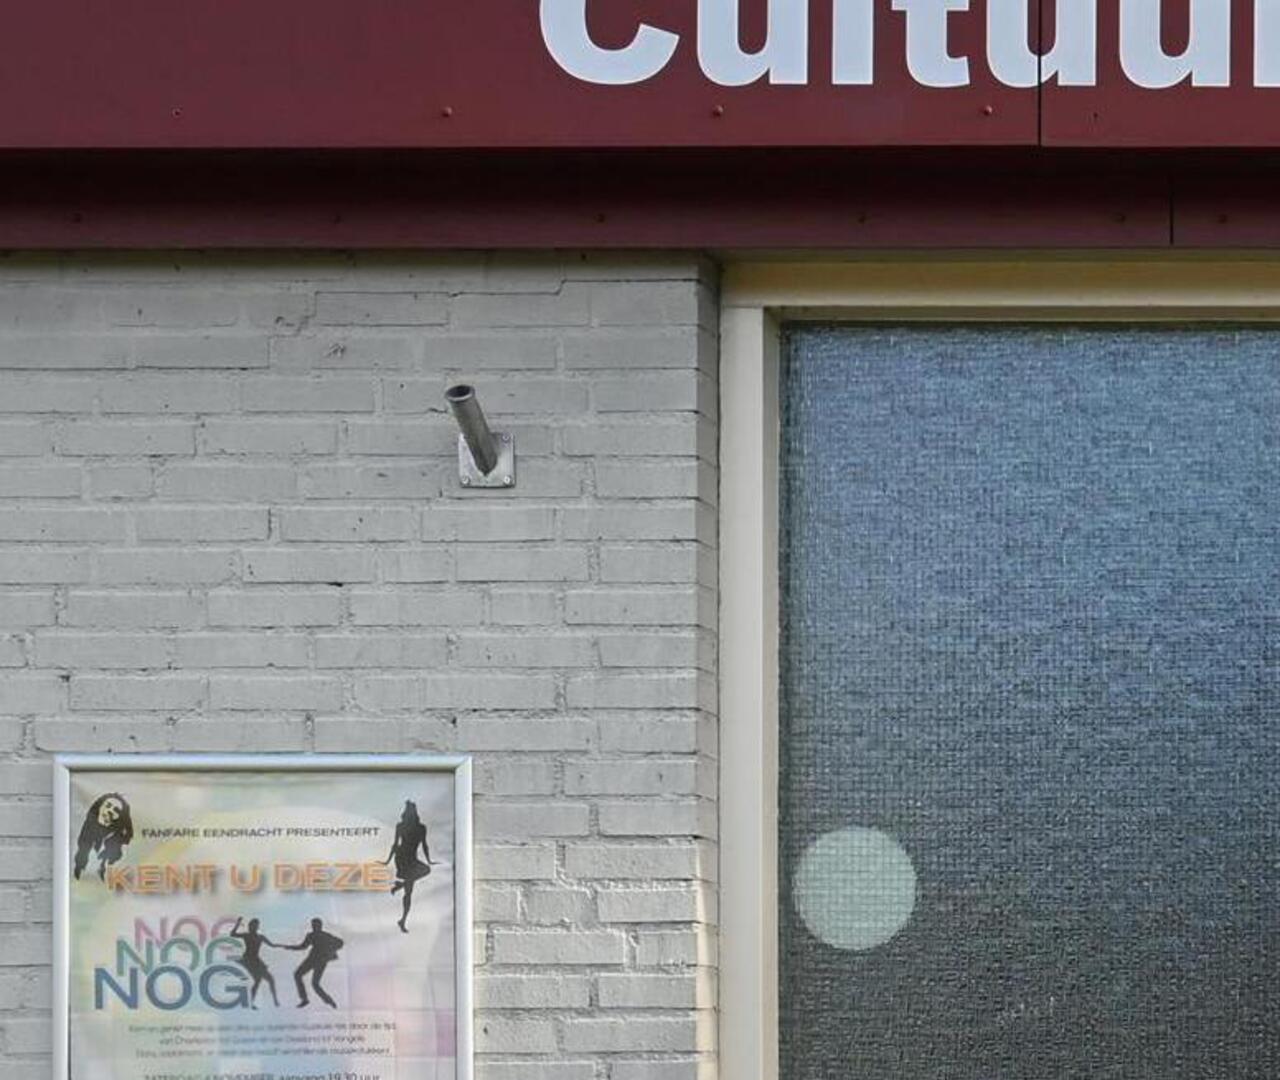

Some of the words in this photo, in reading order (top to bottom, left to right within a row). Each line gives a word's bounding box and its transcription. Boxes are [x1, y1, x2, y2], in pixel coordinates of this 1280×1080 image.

[141, 827, 201, 838] FANFARE
[203, 826, 283, 838] EENDRACHT
[286, 826, 381, 838] PRESENTEERT
[107, 864, 216, 893] KENT
[229, 864, 263, 893] U
[273, 862, 392, 892] DEZE
[94, 964, 249, 1010] NOG
